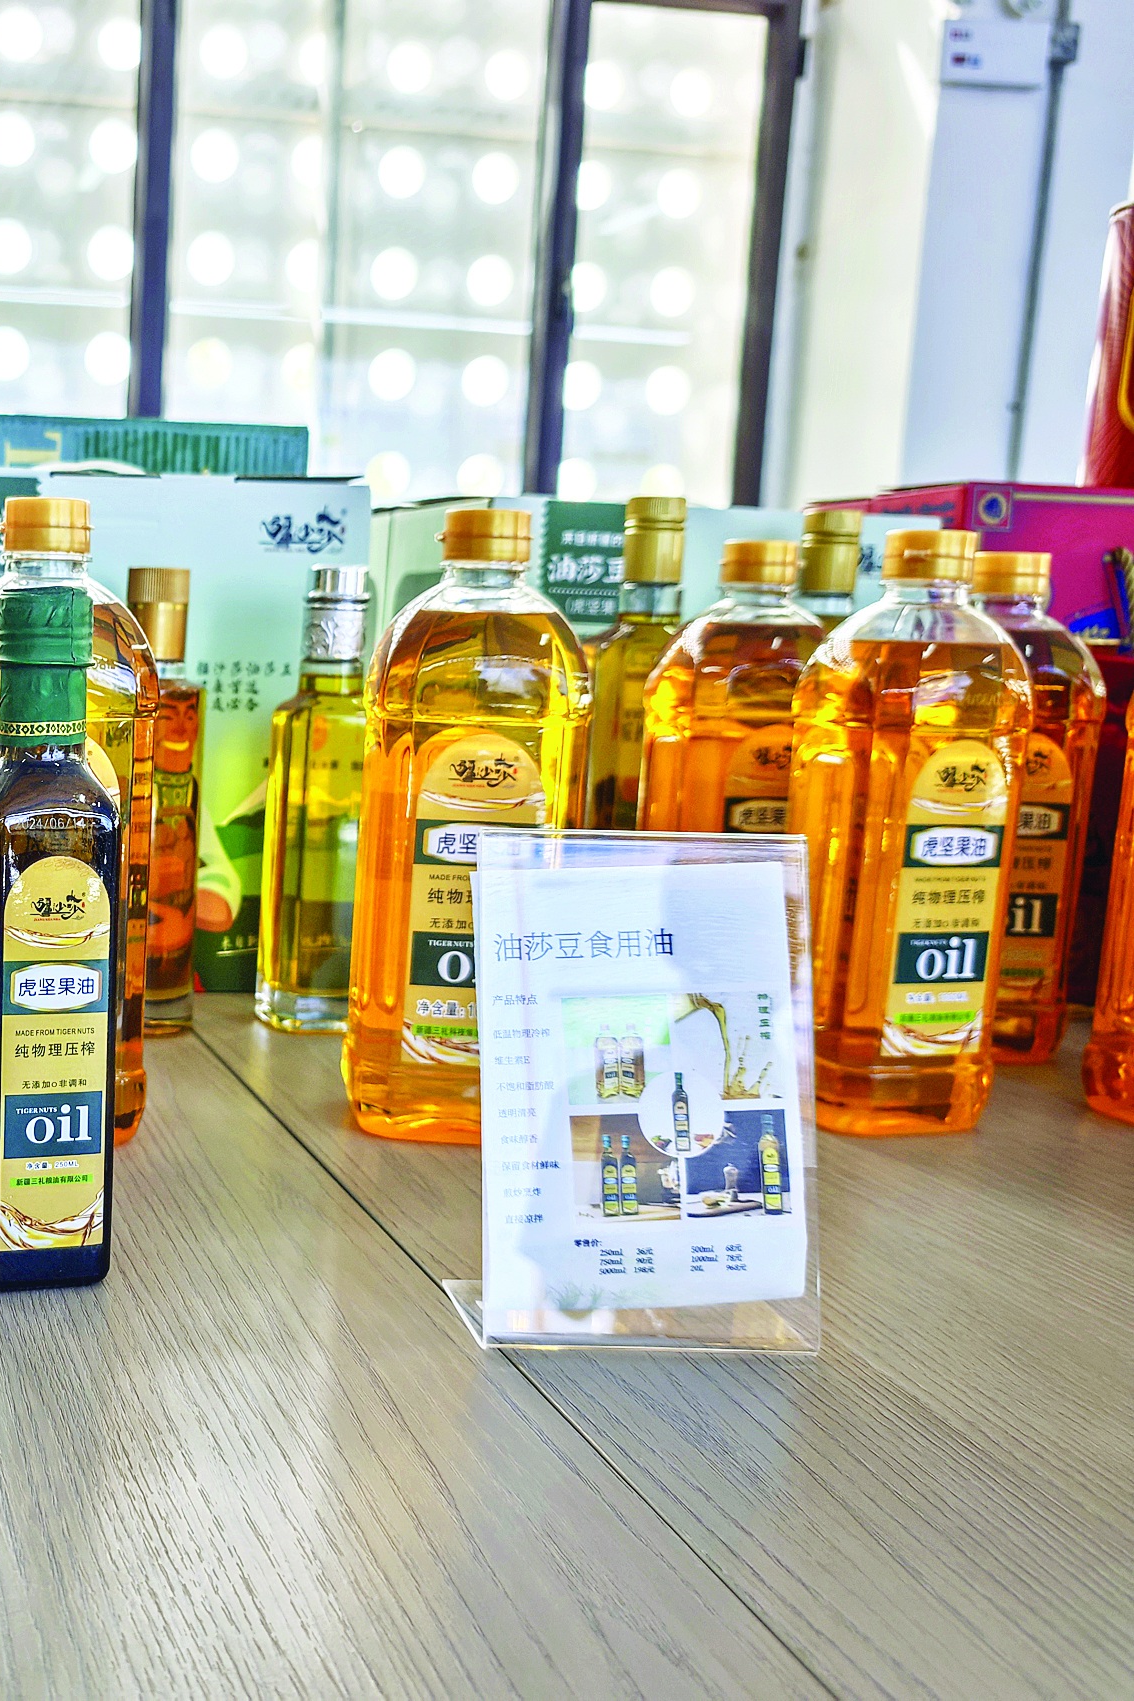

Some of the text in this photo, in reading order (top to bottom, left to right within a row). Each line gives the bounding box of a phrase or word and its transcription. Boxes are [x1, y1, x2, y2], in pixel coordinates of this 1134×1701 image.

[437, 832, 479, 854] 虎坚
[921, 836, 986, 857] 虎坚果油
[912, 889, 986, 904] 纯物理压榨
[1010, 897, 1044, 934] il
[493, 929, 675, 962] 油莎豆食用油
[916, 936, 976, 980] oil
[18, 976, 95, 997] 虎坚果油
[492, 994, 538, 1006] 产品特点
[15, 1029, 34, 1037] MADE
[493, 1028, 550, 1039] 低温物理冷榨
[15, 1040, 95, 1059] 纯物理压榨
[494, 1056, 530, 1065] 维生素E
[496, 1081, 554, 1091] 不饱和脂肪酸
[498, 1108, 537, 1118] 透明清亮
[25, 1103, 92, 1144] oil
[600, 1248, 623, 1257] 250ml
